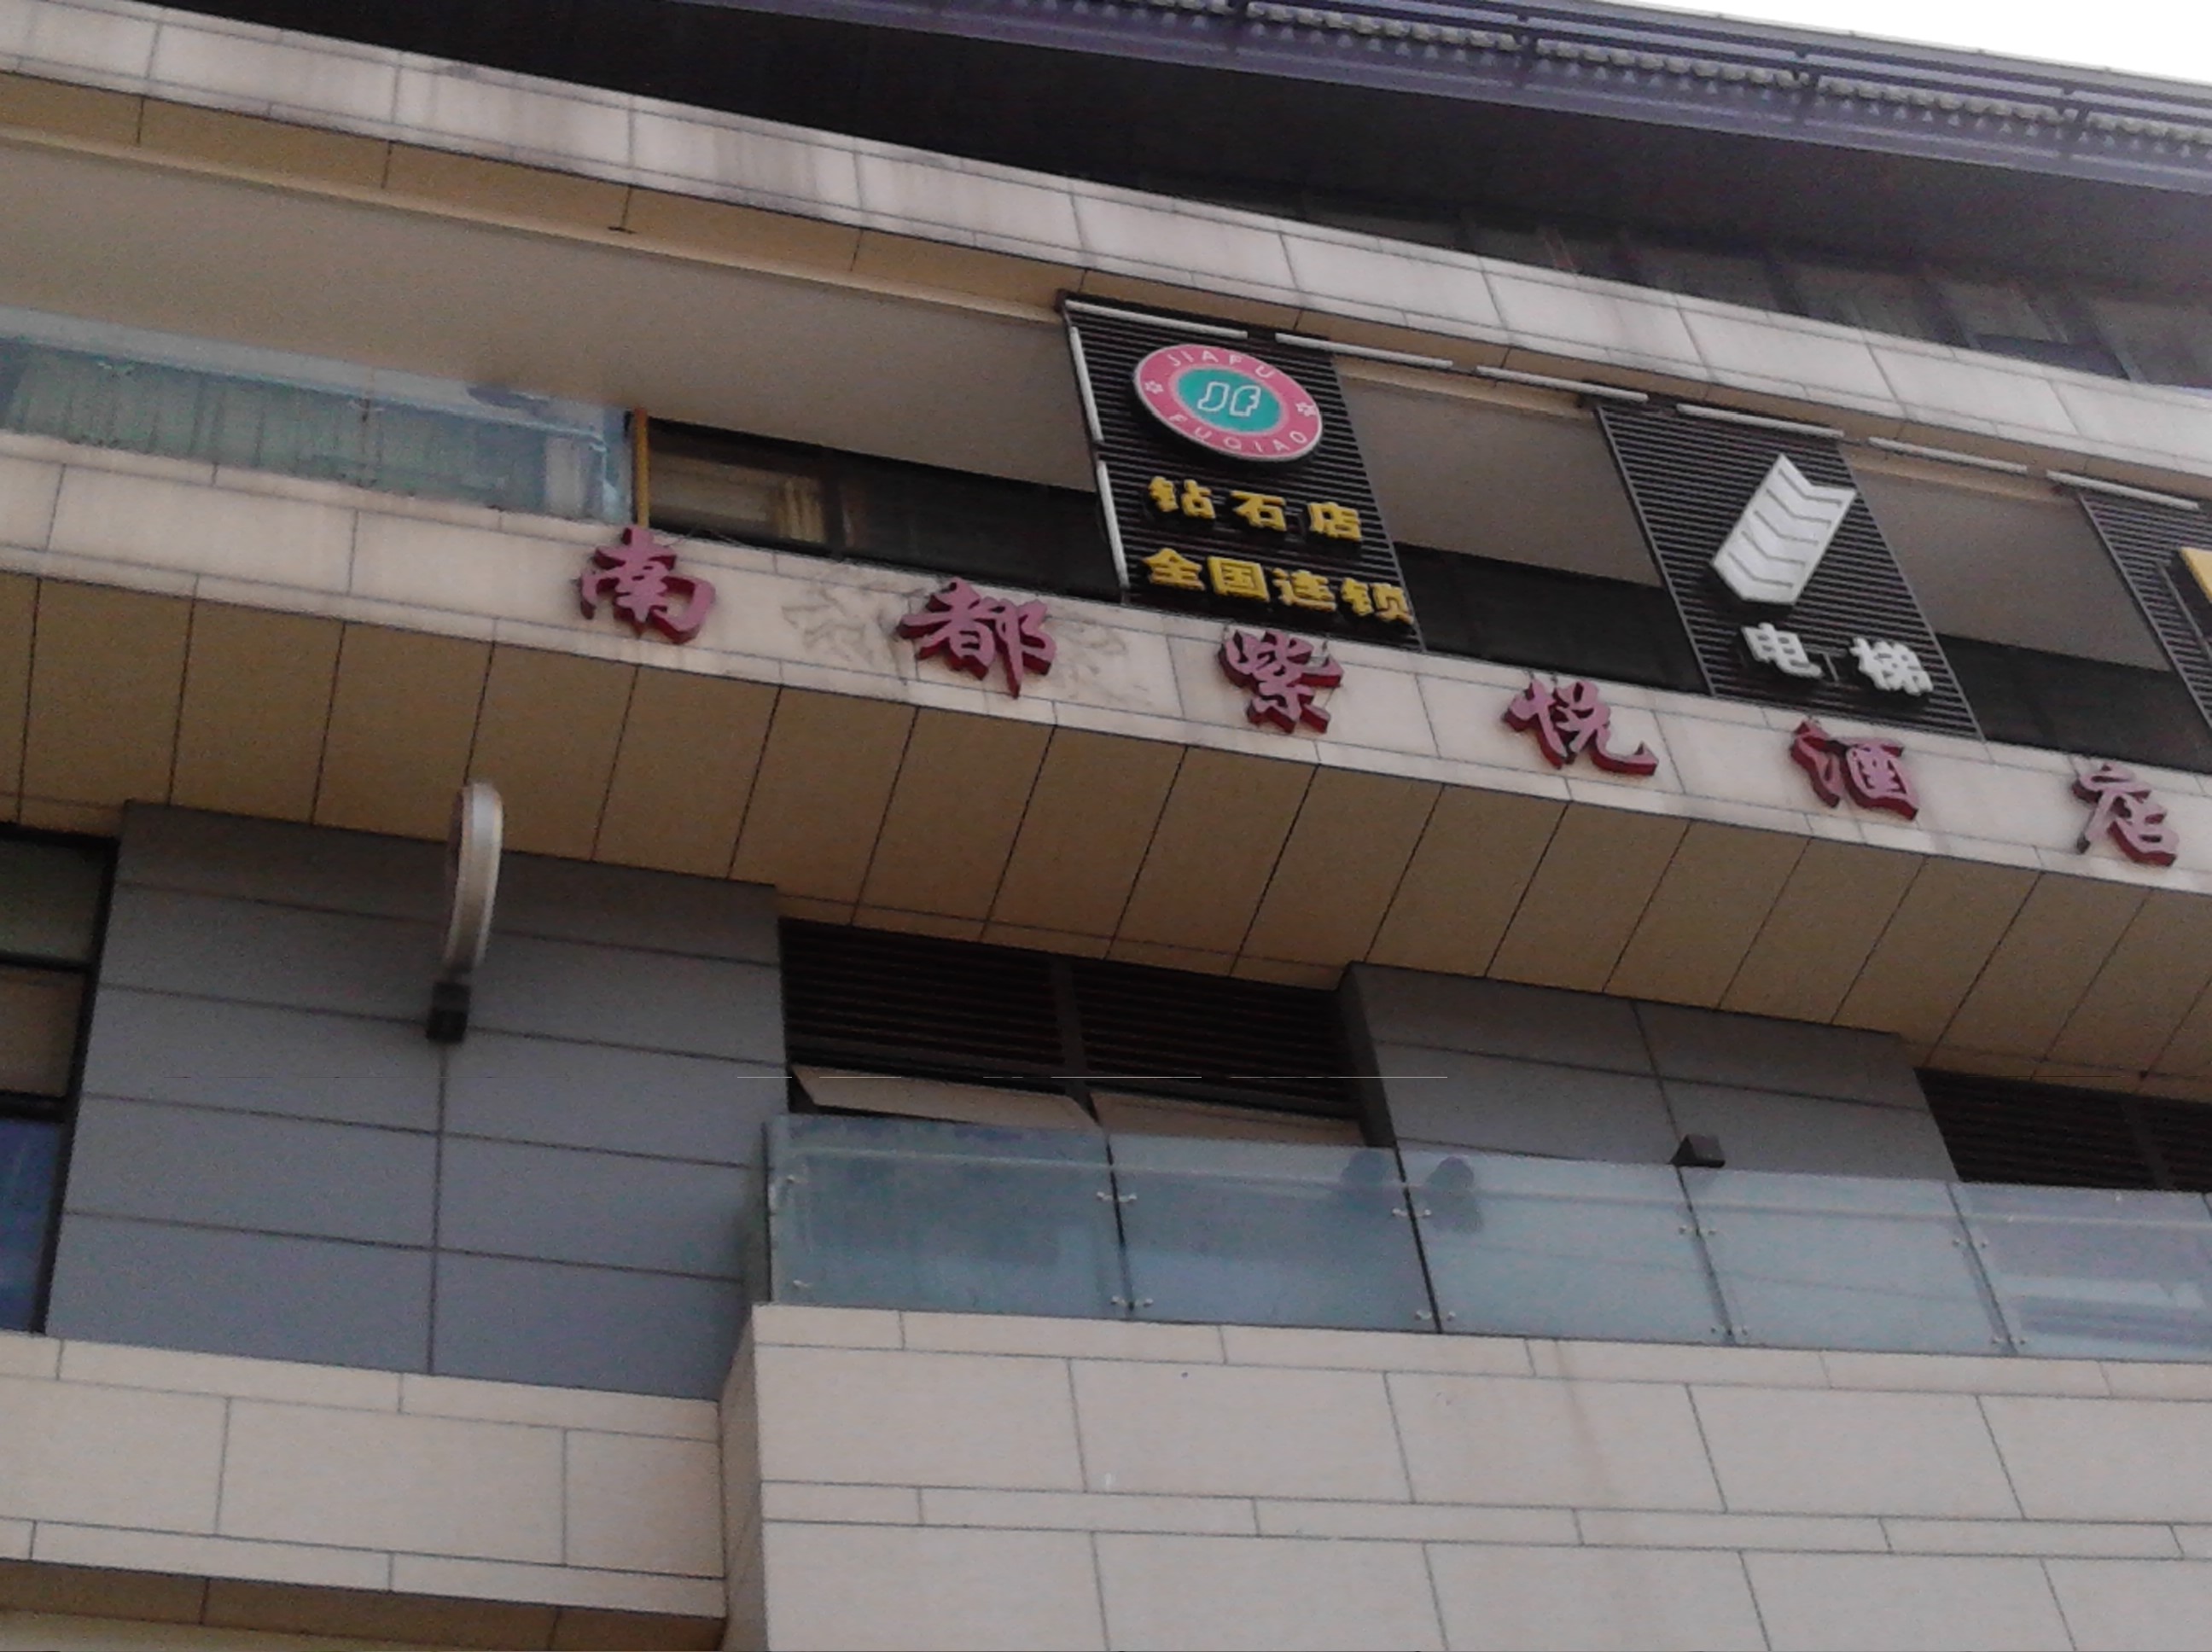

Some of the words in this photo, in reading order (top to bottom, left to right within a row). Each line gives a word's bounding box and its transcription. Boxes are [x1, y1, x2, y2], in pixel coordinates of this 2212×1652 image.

[1167, 350, 1276, 380] JIAFU
[1169, 413, 1308, 454] FUQIAO
[1148, 475, 1364, 542] 钻石店
[1143, 547, 1415, 625] 全国连锁
[1741, 622, 1935, 696] 电梯
[573, 525, 2179, 869] 南都紫悦酒店
